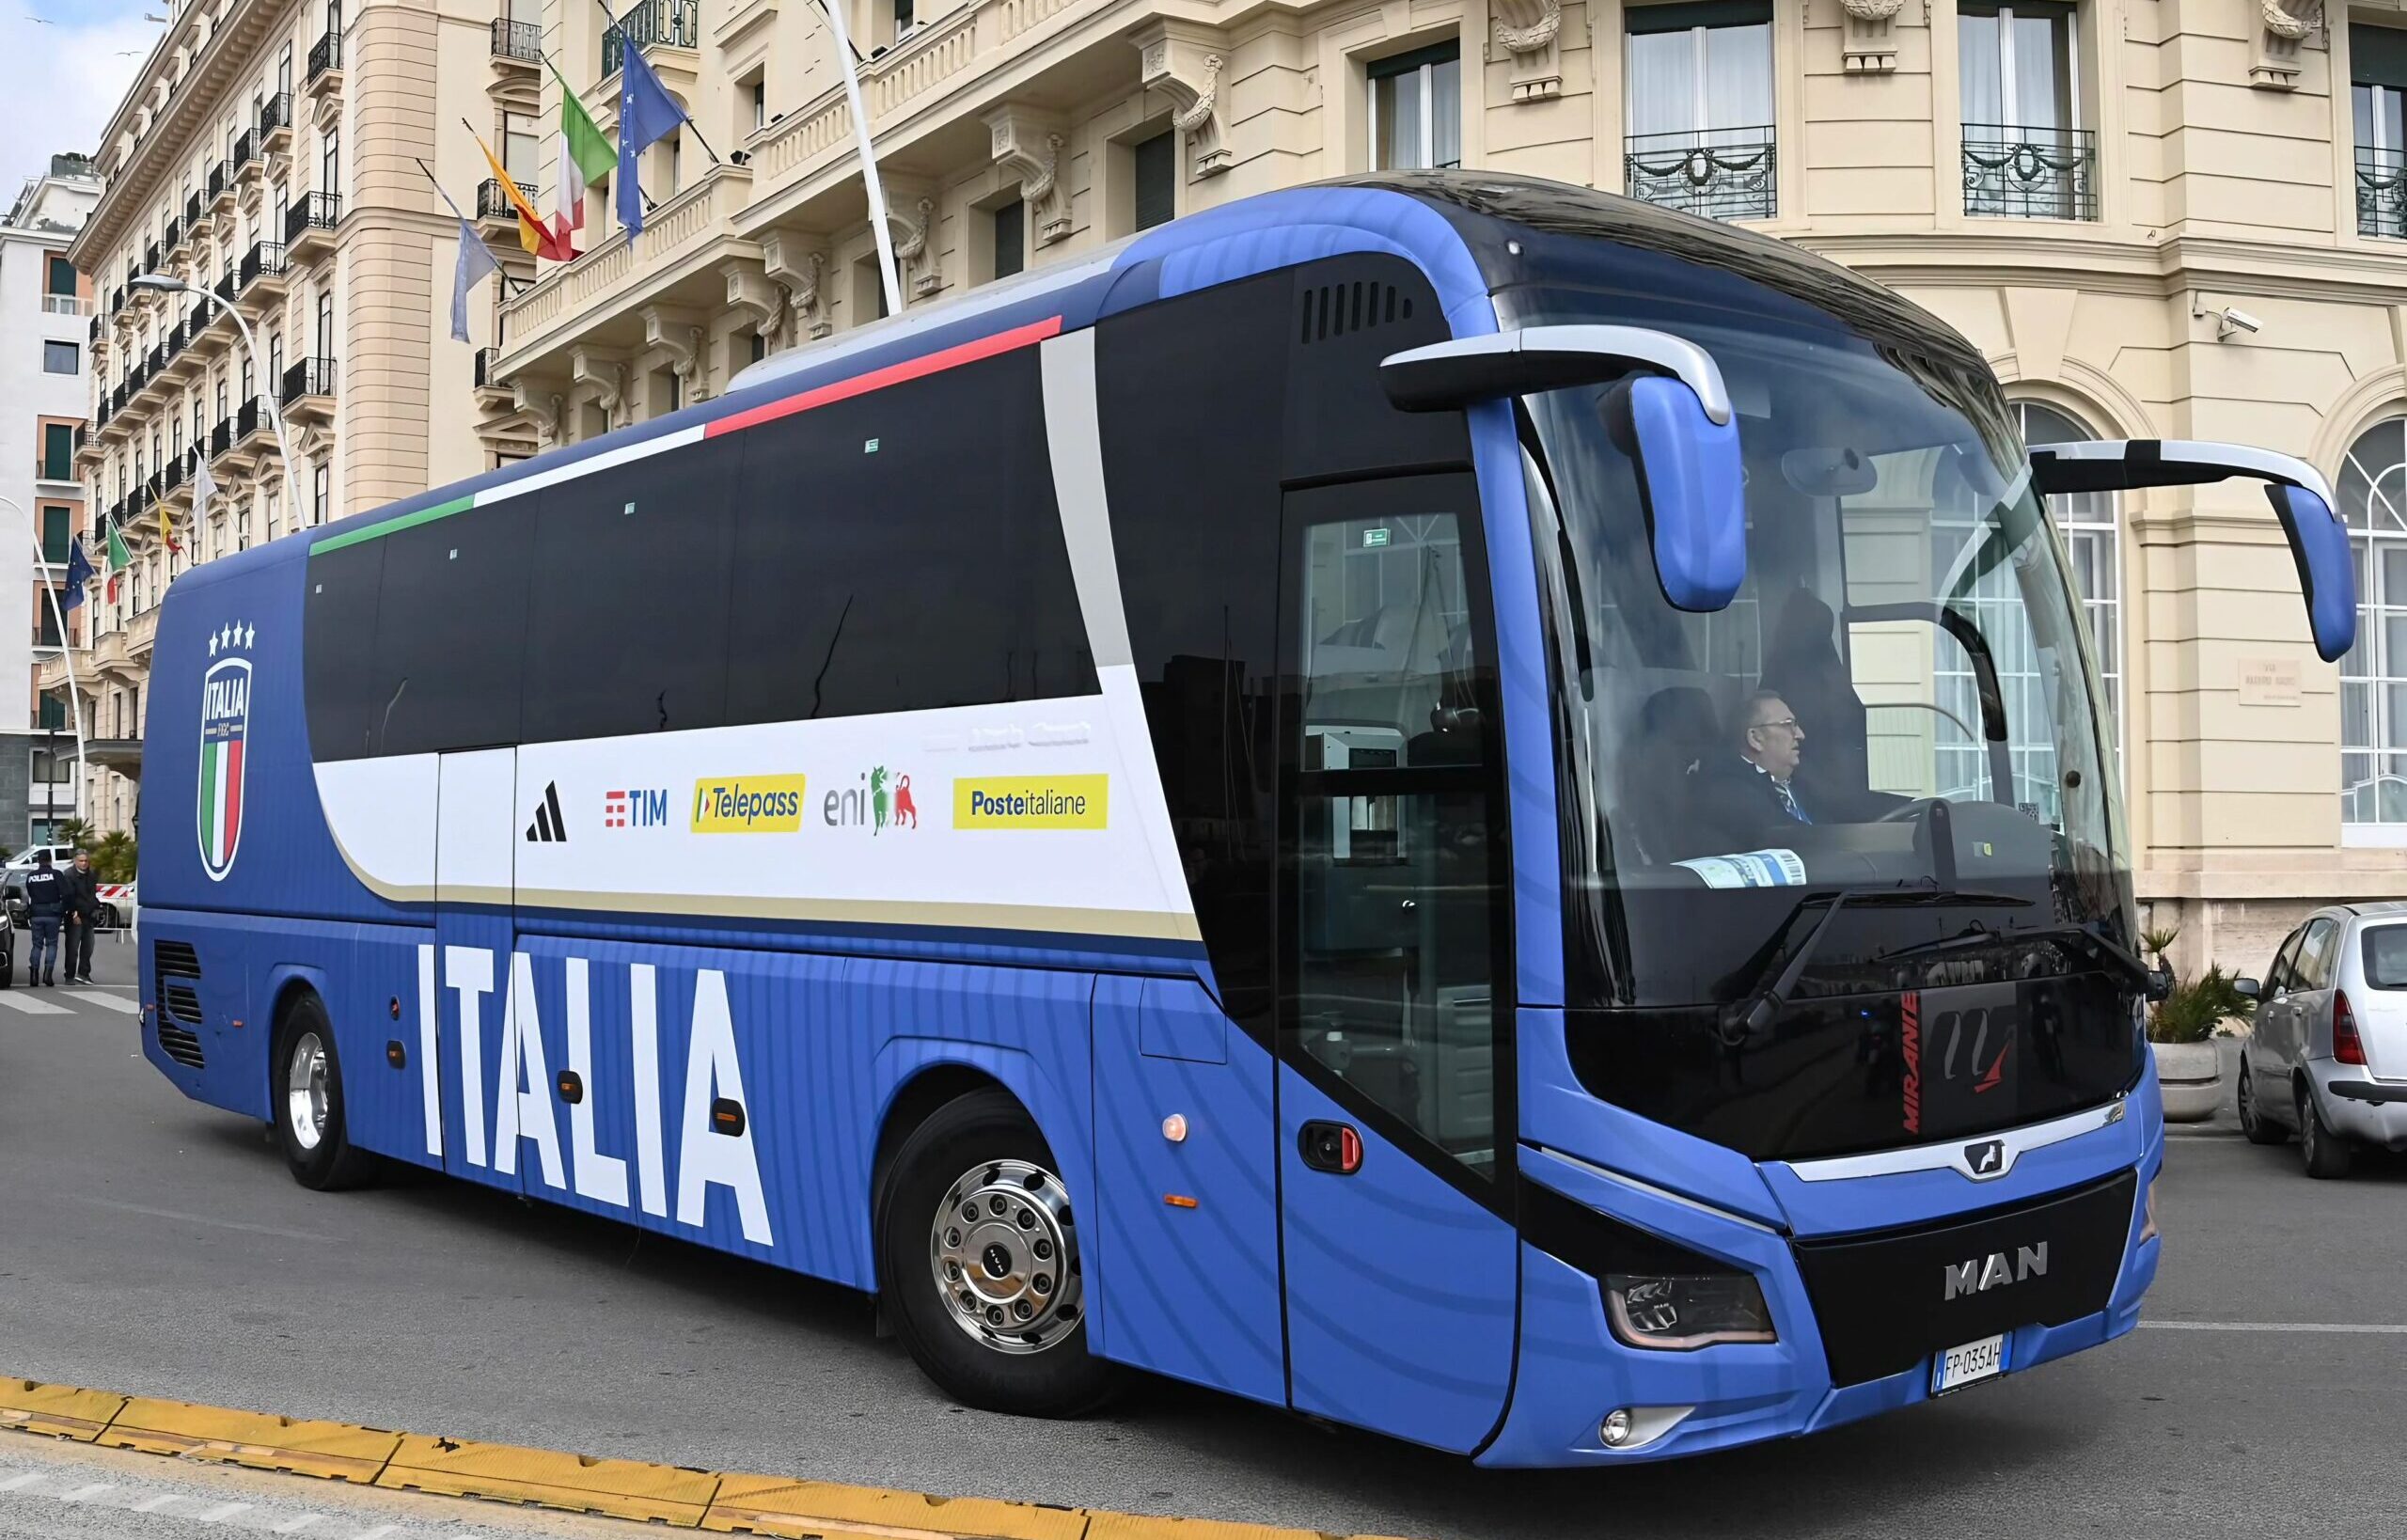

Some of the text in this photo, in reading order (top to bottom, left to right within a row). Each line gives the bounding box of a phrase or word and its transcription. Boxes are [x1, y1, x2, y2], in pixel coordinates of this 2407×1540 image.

[206, 677, 244, 721] ITALIA
[628, 789, 668, 827] TIM
[713, 783, 799, 825] Telepass
[824, 772, 865, 826] eni
[971, 789, 1086, 816] Posteitaliane
[1900, 991, 1919, 1136] MIRANTE
[417, 944, 774, 1247] ITALIA
[1943, 1241, 2048, 1301] MAN
